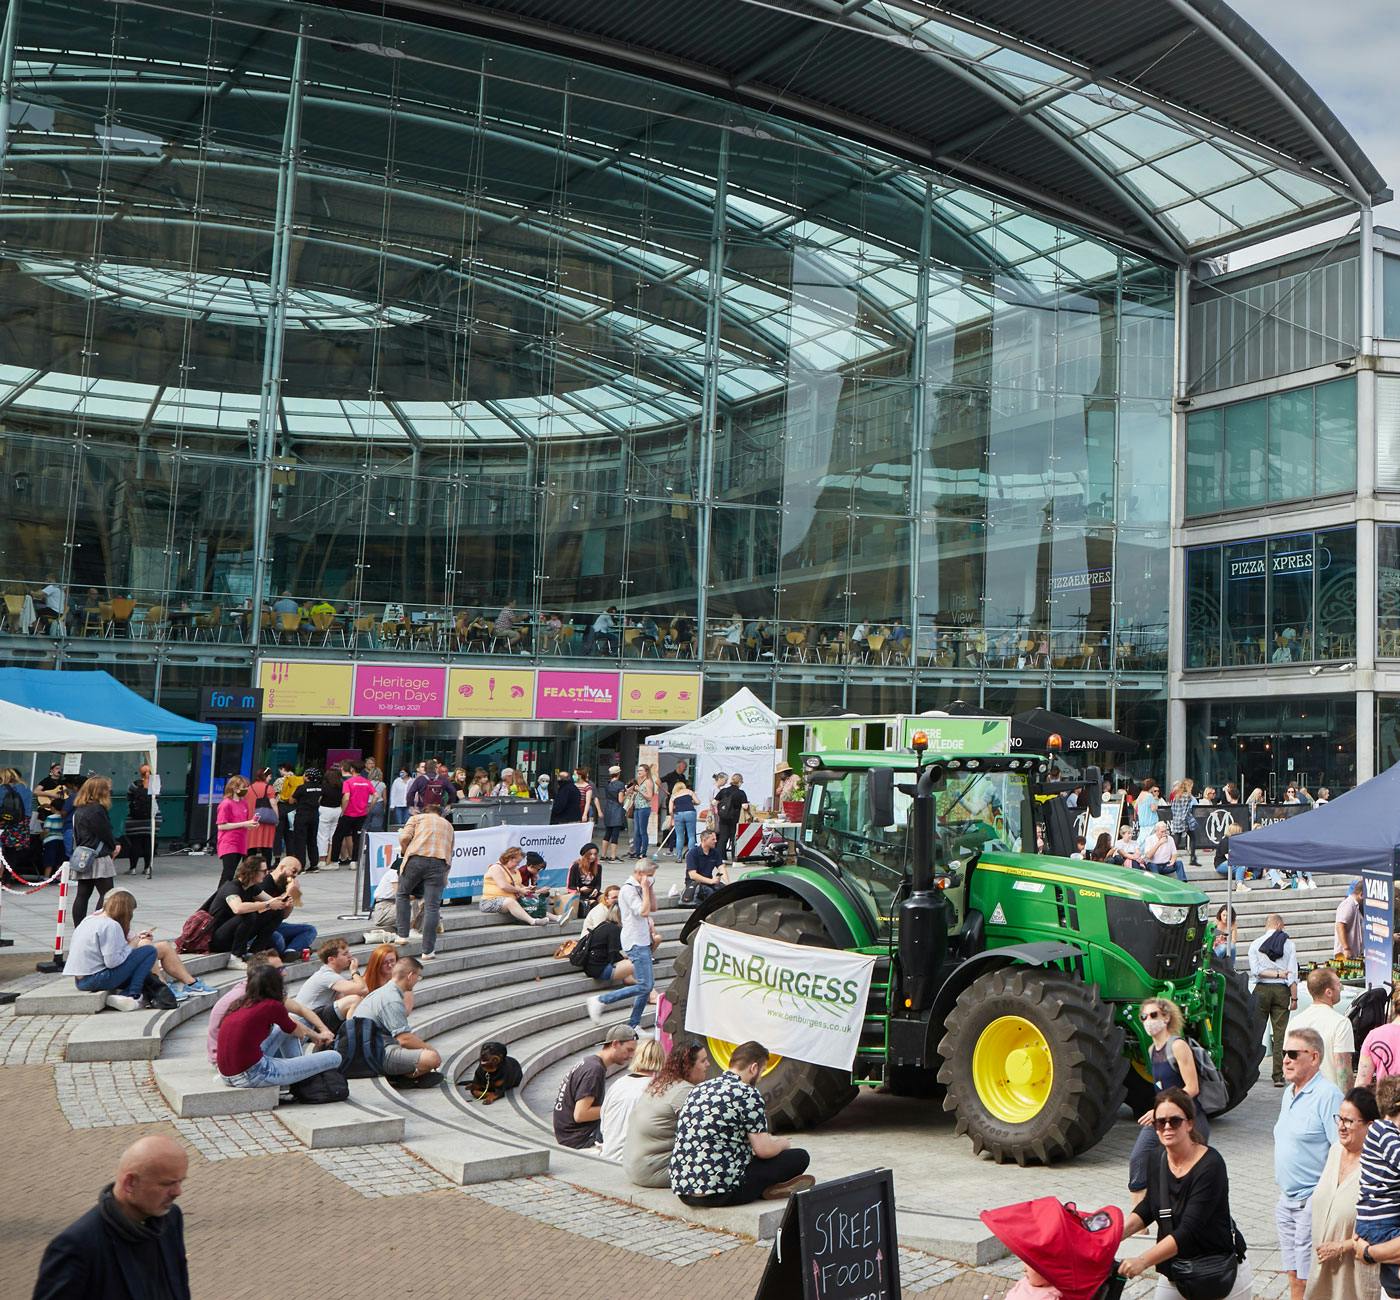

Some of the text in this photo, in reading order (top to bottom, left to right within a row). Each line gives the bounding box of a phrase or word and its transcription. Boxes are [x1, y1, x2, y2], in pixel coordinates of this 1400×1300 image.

[1231, 553, 1313, 576] PIZZAXPRES
[372, 675, 430, 690] Heritage
[363, 688, 438, 703] Open Days
[543, 685, 612, 698] FEASTIVAL
[910, 728, 942, 739] WERE
[911, 739, 964, 750] WLEDGE
[1069, 740, 1099, 749] RZANO
[519, 835, 567, 847] Committed
[1365, 878, 1389, 901] YANA
[767, 1008, 852, 1033] www.benburgess.co.uk
[814, 1200, 882, 1255] STREET
[822, 1259, 875, 1294] FOOD
